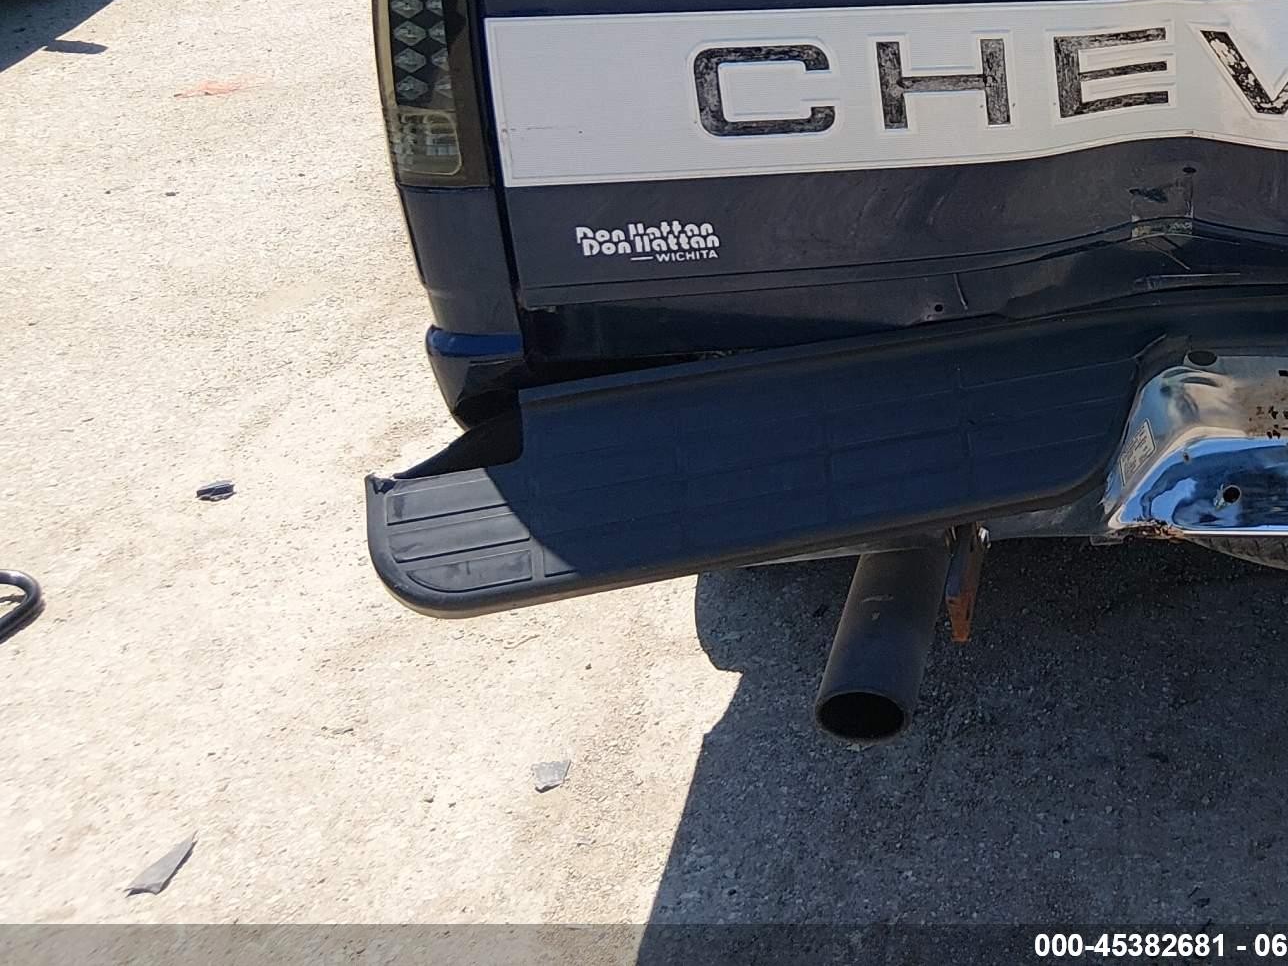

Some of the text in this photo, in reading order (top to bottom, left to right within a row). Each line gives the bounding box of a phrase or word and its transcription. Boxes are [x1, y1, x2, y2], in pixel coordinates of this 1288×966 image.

[582, 233, 720, 256] Don Hattan
[656, 250, 719, 262] WICHITA
